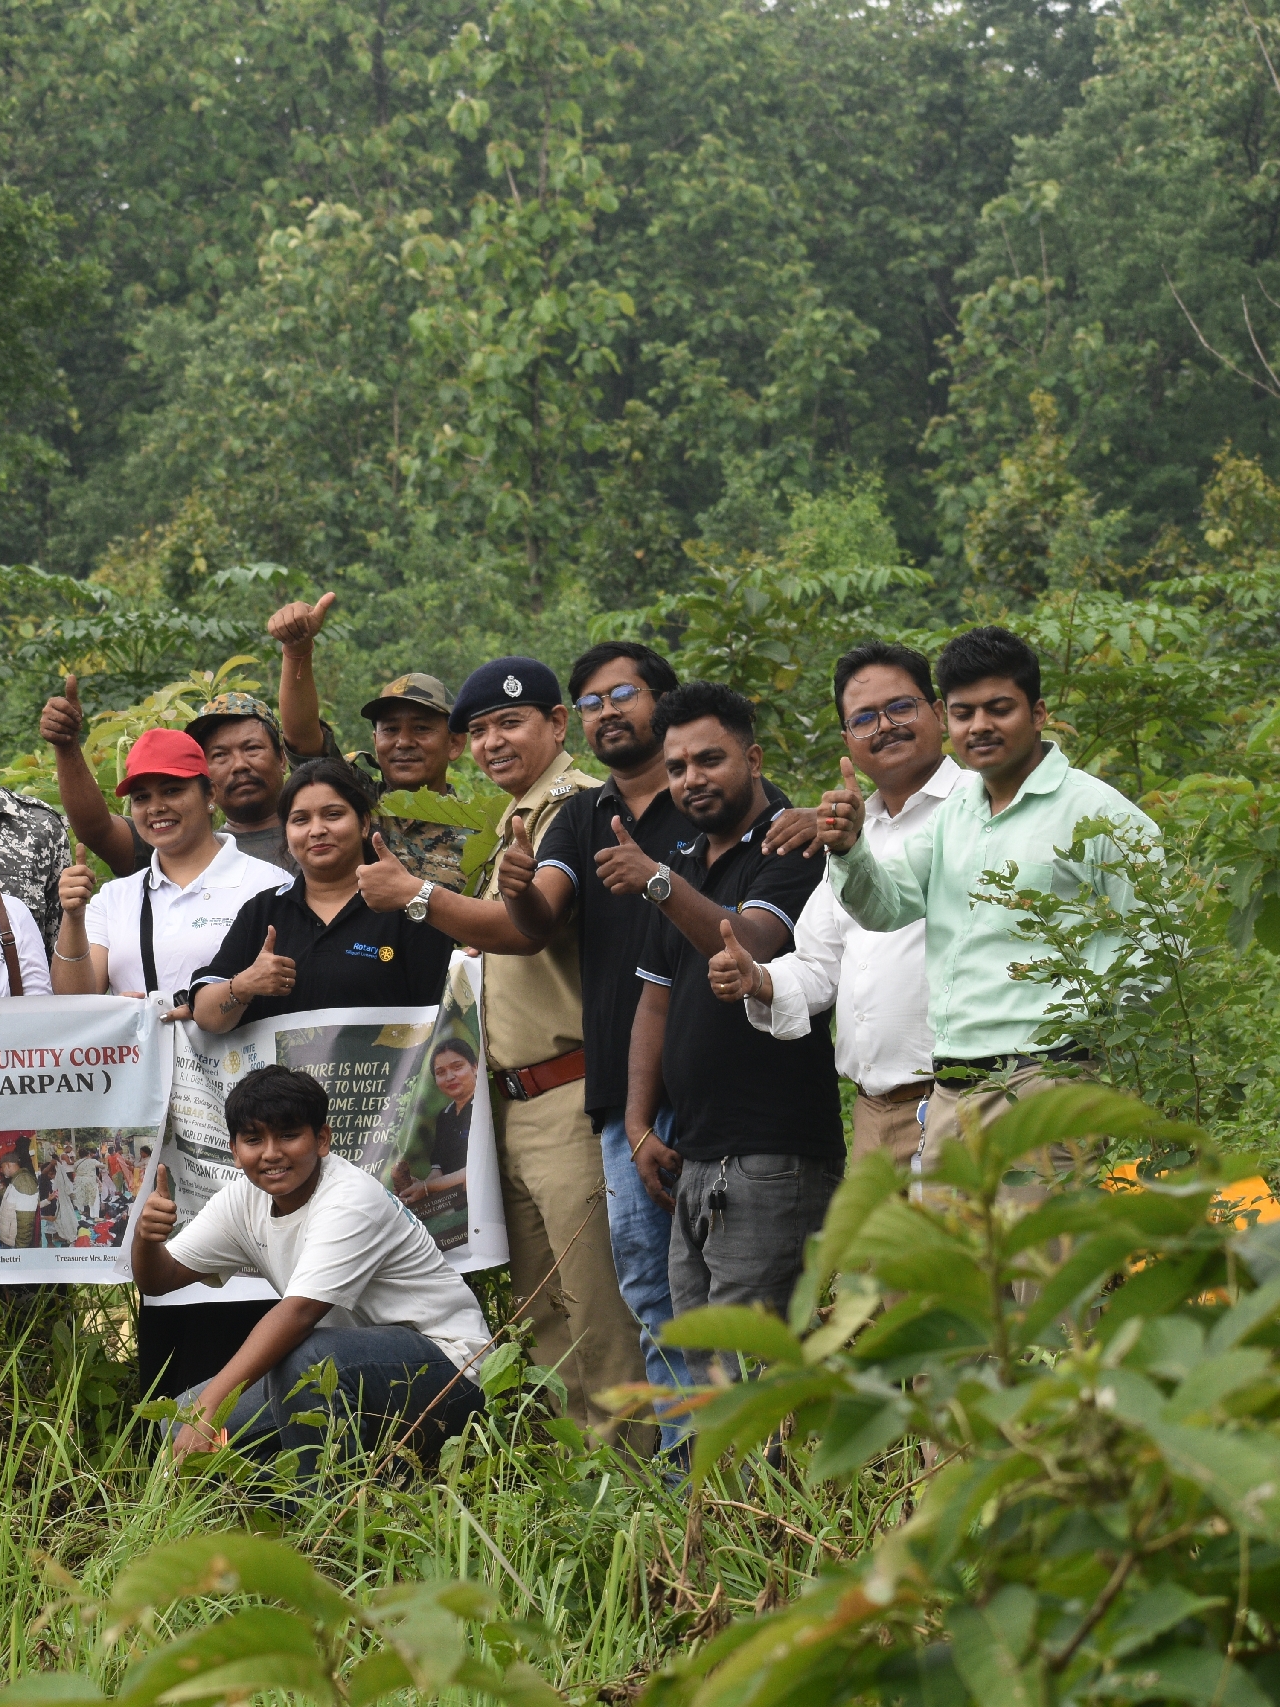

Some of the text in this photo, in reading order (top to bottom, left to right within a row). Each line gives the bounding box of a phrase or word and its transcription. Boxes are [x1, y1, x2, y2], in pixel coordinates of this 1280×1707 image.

[550, 784, 571, 796] WBP
[353, 943, 378, 954] Rotary
[70, 1044, 140, 1067] CORPS
[338, 1062, 351, 1075] IS
[354, 1062, 380, 1076] NOT
[381, 1062, 390, 1075] A
[335, 1080, 349, 1093] TO
[352, 1079, 386, 1093] VISIT.
[328, 1096, 390, 1111] OME. LETS
[358, 1131, 372, 1145] IT
[372, 1130, 390, 1143] ON
[440, 1231, 468, 1247] Treasure
